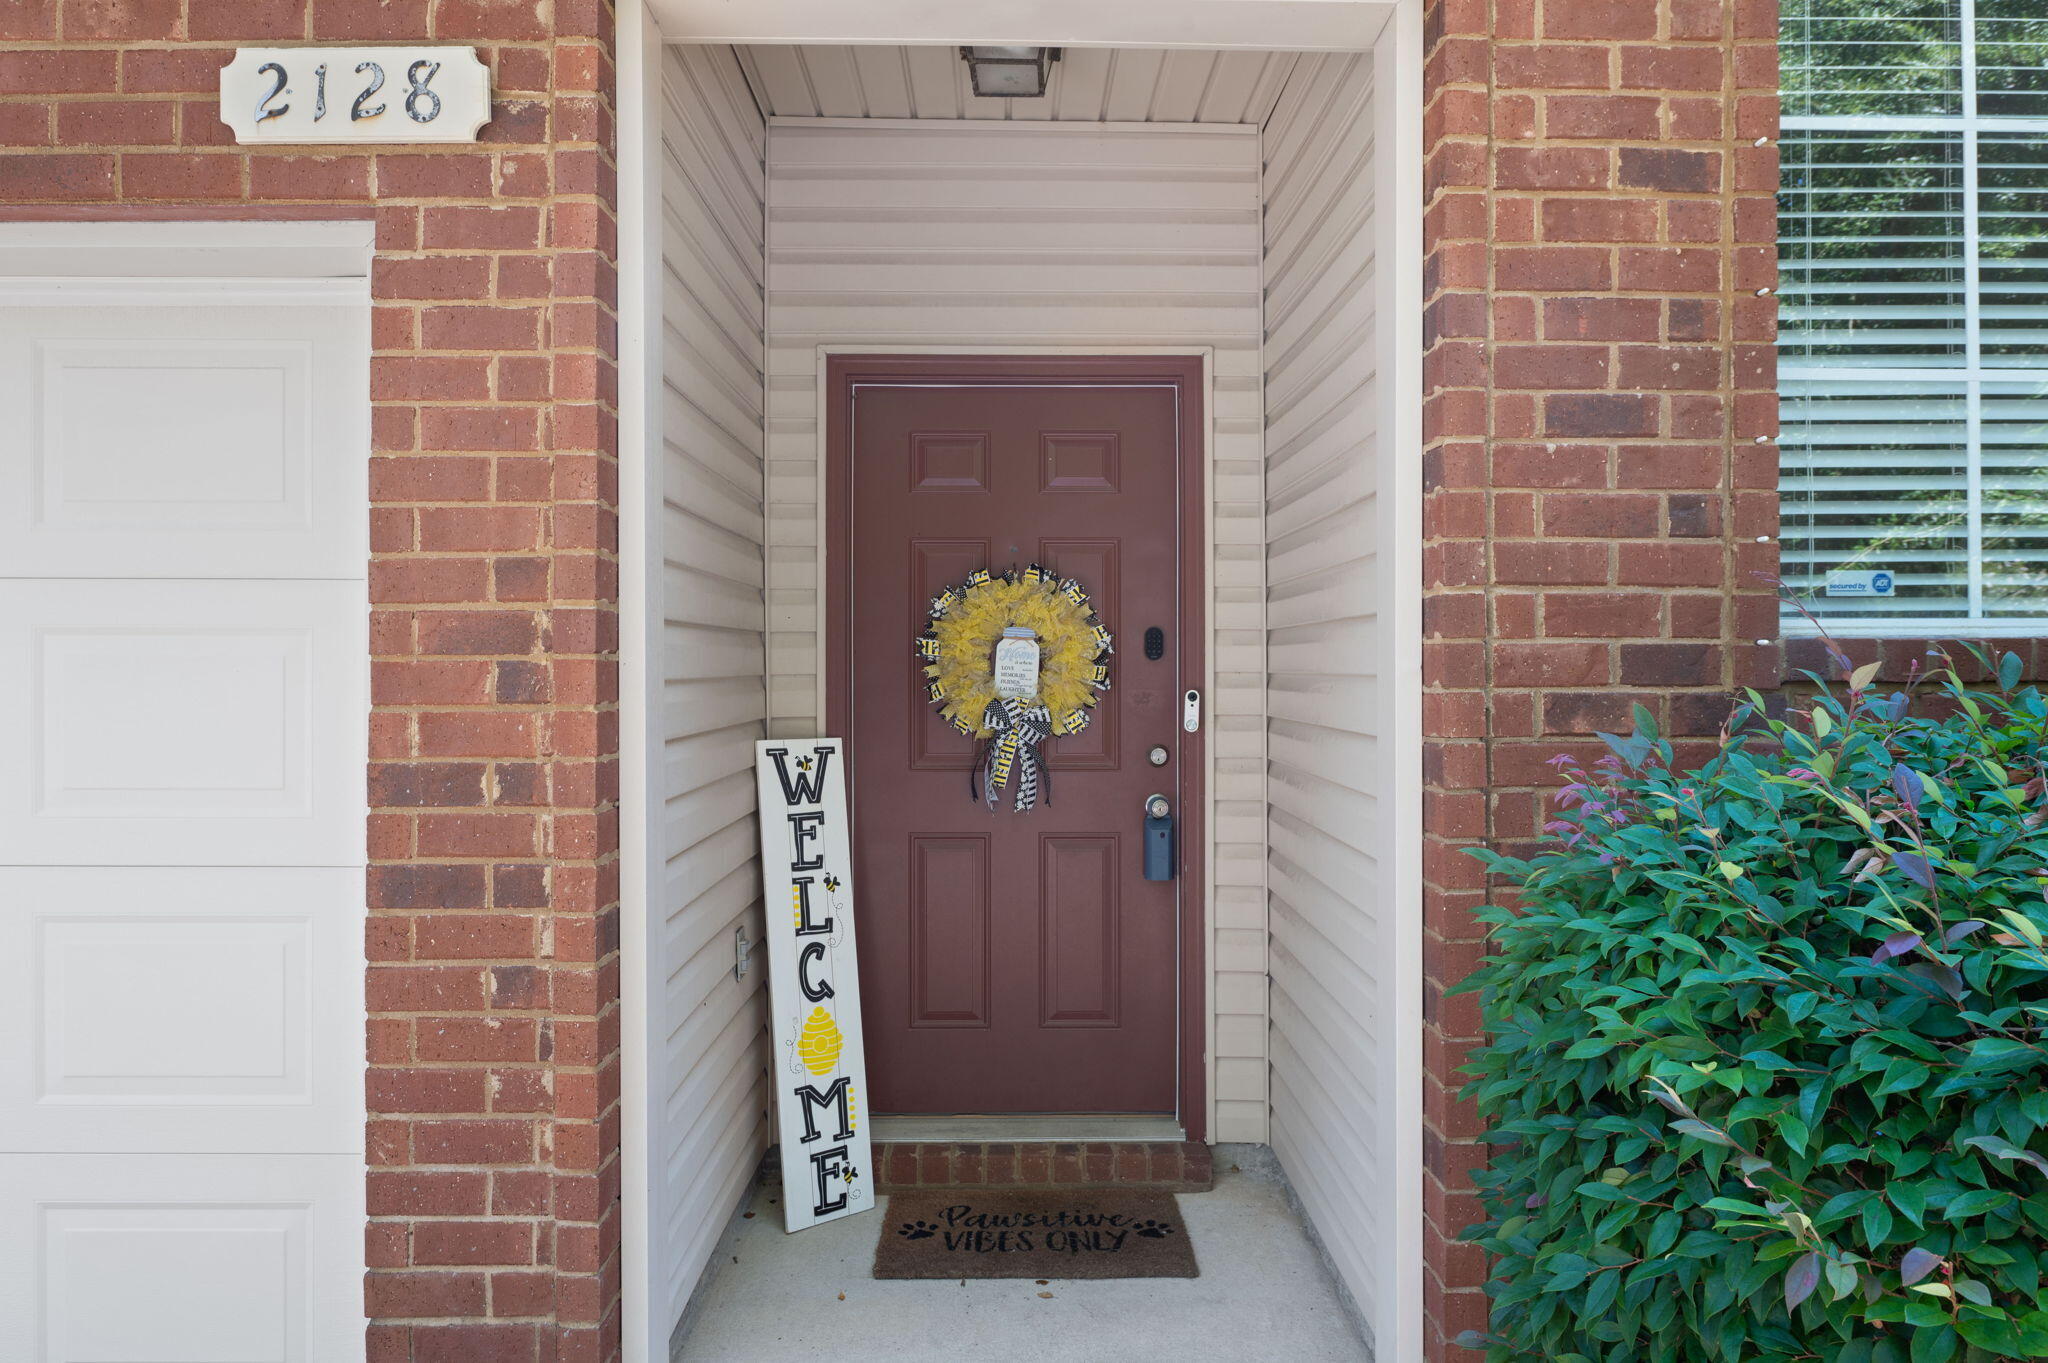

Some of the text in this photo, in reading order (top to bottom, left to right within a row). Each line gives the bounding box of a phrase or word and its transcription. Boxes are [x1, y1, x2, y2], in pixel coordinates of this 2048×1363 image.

[254, 59, 441, 123] 2128
[999, 647, 1036, 661] Home
[937, 1205, 1134, 1228] Pawsitive
[943, 1229, 1130, 1253] VIBES ONLY
